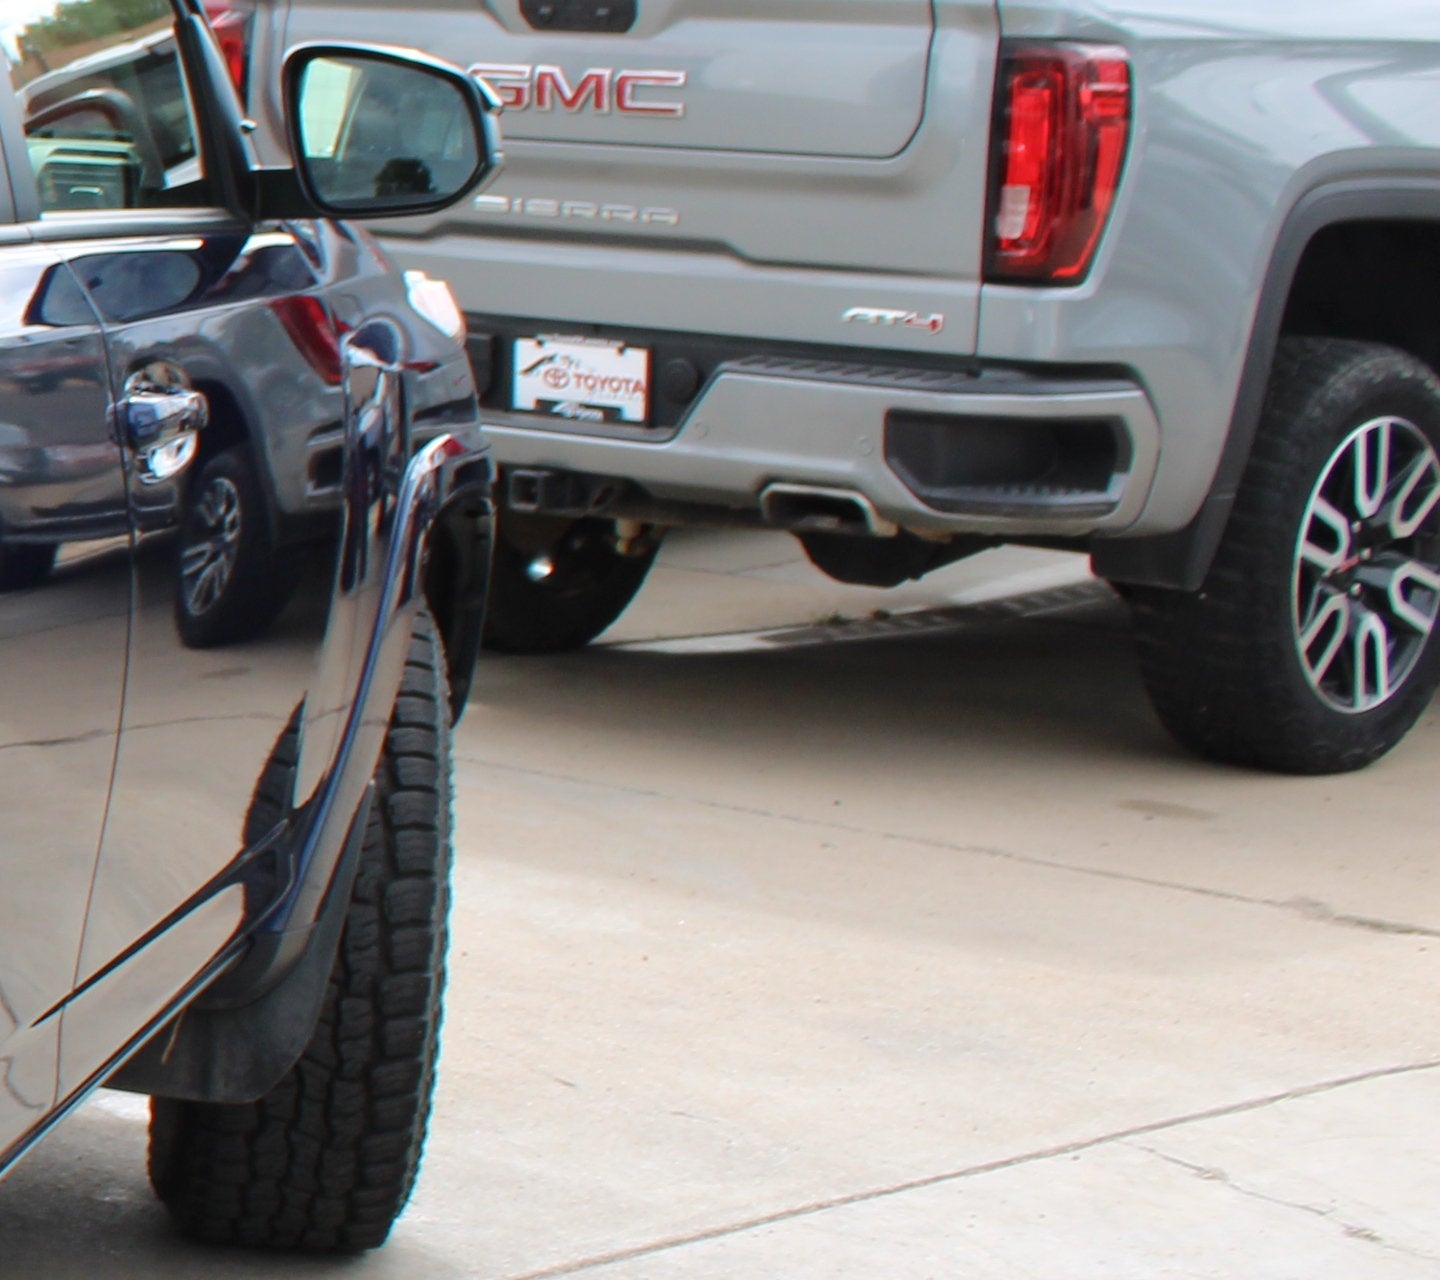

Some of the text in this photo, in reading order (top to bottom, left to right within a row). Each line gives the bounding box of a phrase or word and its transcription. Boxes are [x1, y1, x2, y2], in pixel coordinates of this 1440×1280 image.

[468, 63, 686, 117] GMC
[473, 195, 678, 224] SIERRA
[842, 307, 944, 335] AT4
[574, 373, 646, 396] TOYOTA
